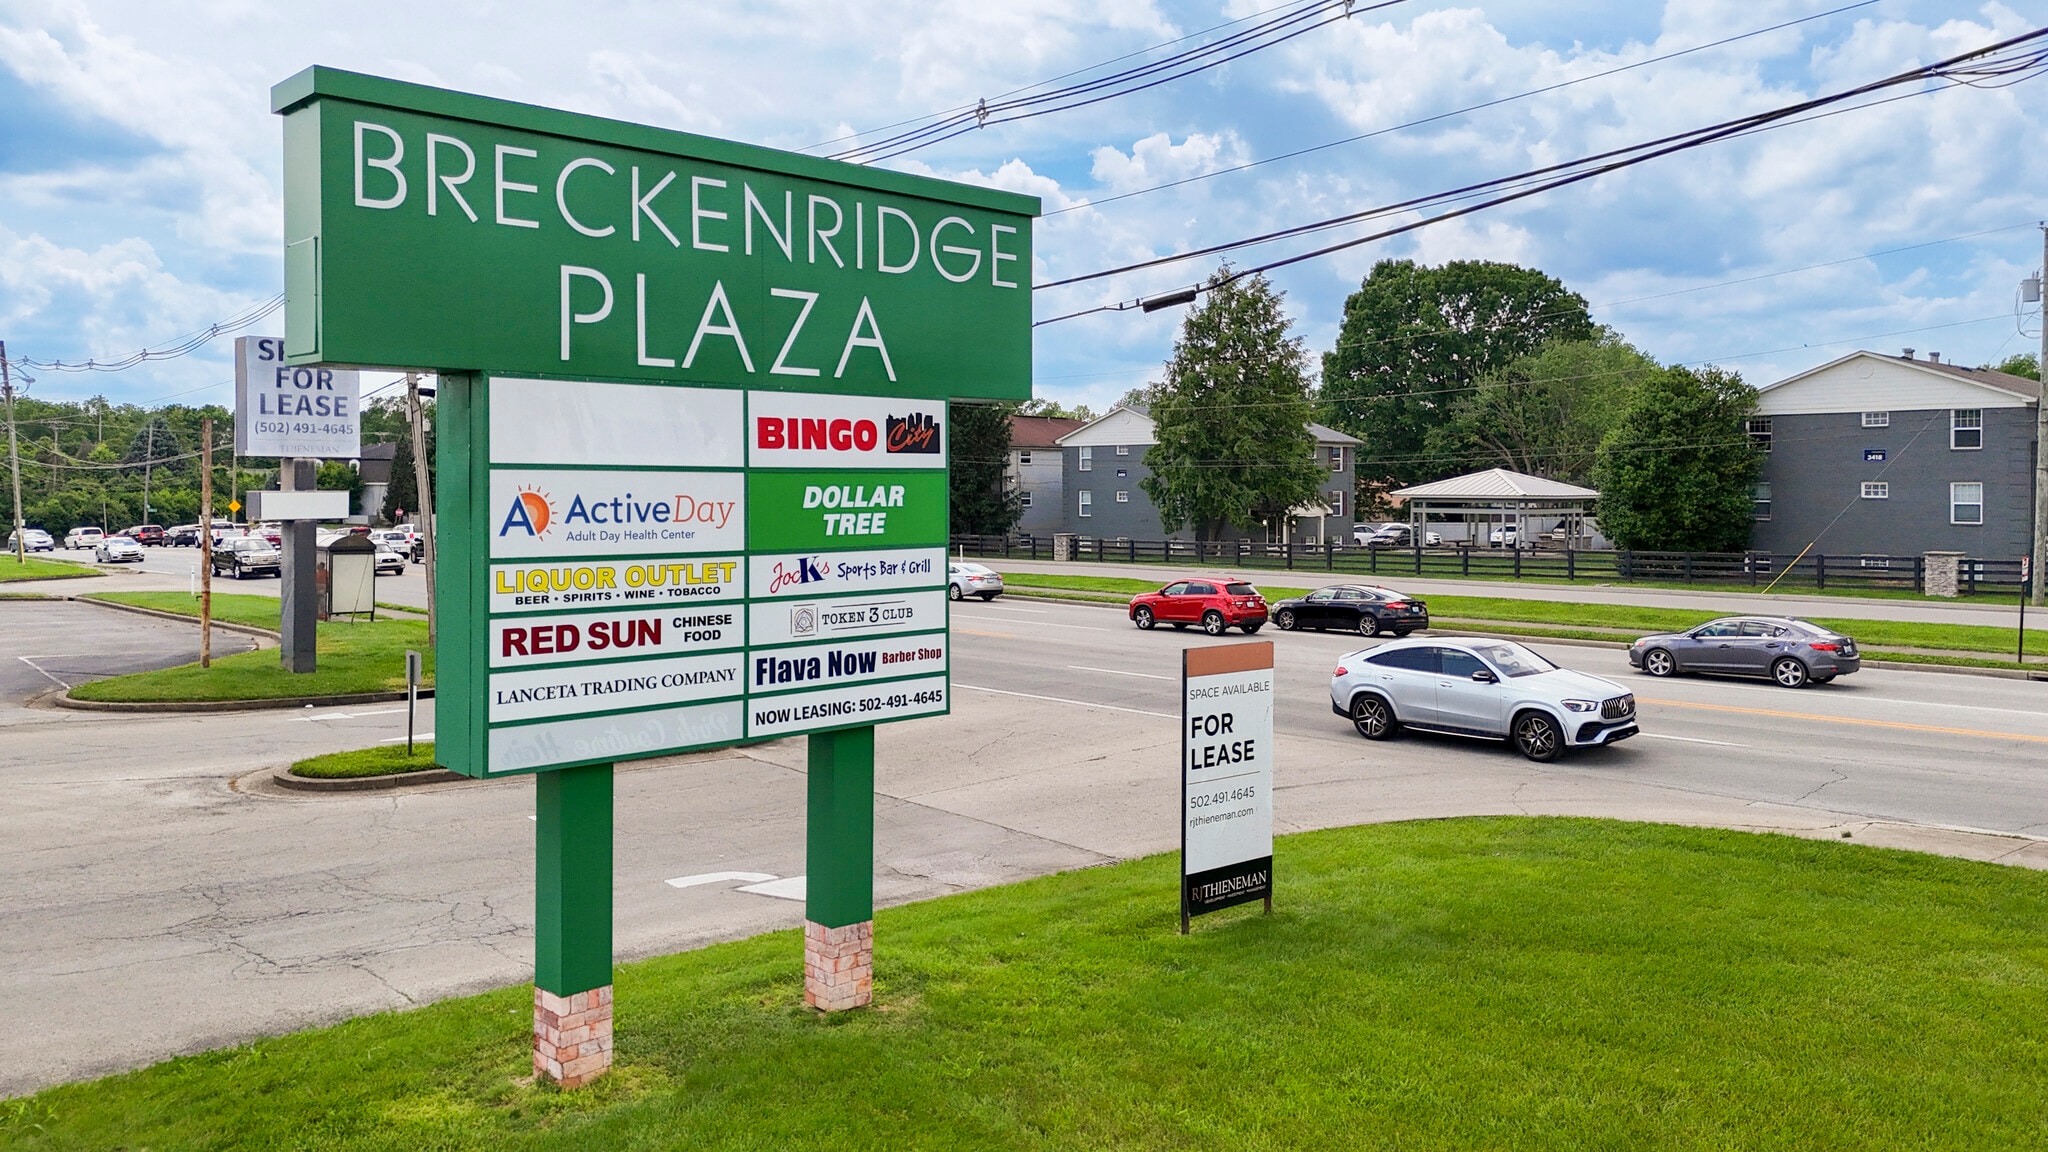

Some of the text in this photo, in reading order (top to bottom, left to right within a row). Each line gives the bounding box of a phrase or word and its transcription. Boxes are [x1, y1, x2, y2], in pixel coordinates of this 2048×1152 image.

[354, 121, 1017, 289] BRECKENRIDGE
[560, 265, 896, 382] PLAZA
[276, 367, 333, 391] FOR
[260, 393, 348, 417] LEASE
[255, 422, 354, 436] (502) 491-4645
[757, 417, 877, 452] BINGO
[887, 419, 935, 452] City
[803, 485, 905, 509] DOLLAR
[564, 493, 736, 529] ActiveDay
[566, 529, 695, 543] Adult Day Health Center
[823, 512, 885, 536] TREE
[495, 562, 737, 594] LIQUOR OUTLET
[837, 562, 877, 581] Sports
[880, 560, 898, 576] Bar
[901, 560, 906, 574] &
[909, 558, 931, 573] Grill
[515, 586, 721, 605] BEER SPIRITS WINE TOBACCO
[672, 614, 732, 628] CHINESE
[822, 607, 914, 626] TOKEN 3 CLUB
[502, 619, 662, 657] RED SUN
[684, 629, 721, 642] FOOD
[756, 650, 877, 686] Flava Now
[882, 648, 942, 664] Barber Shop
[497, 668, 737, 705] LANCETA TRADING COMPANY
[1190, 680, 1270, 700] SPACE AVAILABLE
[755, 689, 942, 726] NOW LEASING: 502-491-4645
[1191, 712, 1233, 739] FOR
[1191, 739, 1255, 770] LEASE
[1190, 786, 1255, 809] 502.491.4645
[1189, 806, 1254, 829] rjthieneman.com
